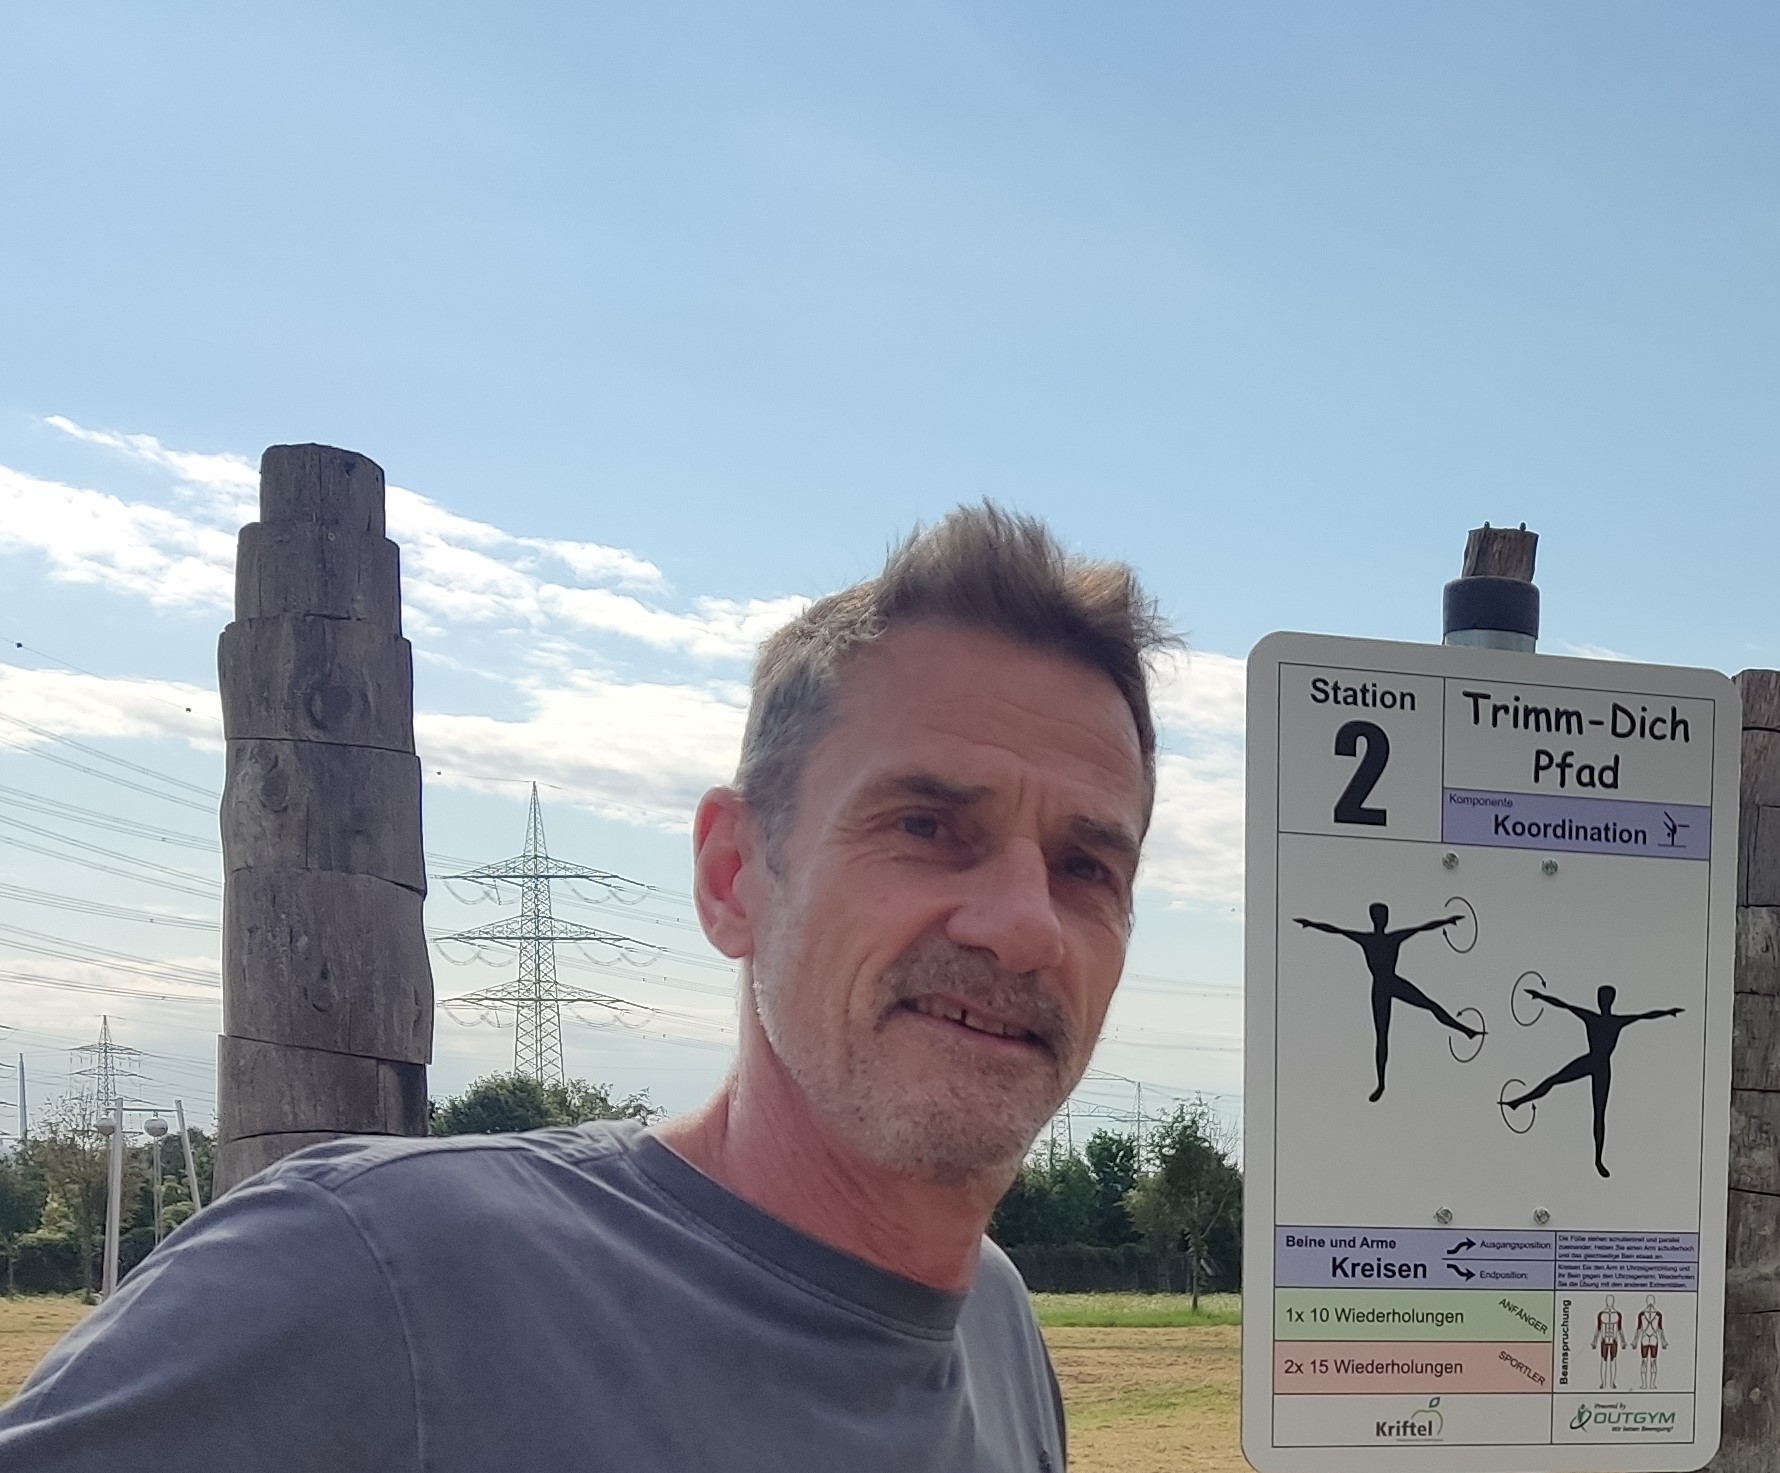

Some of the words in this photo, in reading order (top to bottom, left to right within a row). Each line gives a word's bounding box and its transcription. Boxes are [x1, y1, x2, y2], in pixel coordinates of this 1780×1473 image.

[1310, 677, 1416, 711] Station
[1462, 690, 1690, 743] Trimm-Dich
[1334, 720, 1390, 827] 2
[1534, 749, 1619, 789] Pfad
[1449, 793, 1513, 807] Komponente
[1494, 814, 1647, 845] Koordination
[1286, 1235, 1325, 1248] Beine
[1330, 1236, 1356, 1248] und
[1359, 1237, 1396, 1249] Arme
[1332, 1257, 1427, 1279] Kreisen
[1286, 1307, 1304, 1322] 1x
[1310, 1307, 1329, 1322] 10
[1335, 1308, 1463, 1327] Wiederholungen
[1498, 1299, 1548, 1335] ANFÄNGER
[1559, 1300, 1572, 1384] Beanspruchung
[1284, 1359, 1304, 1374] 2x
[1310, 1359, 1329, 1374] 15
[1334, 1359, 1463, 1377] Wiederholungen
[1498, 1351, 1545, 1386] SPORTLER
[1376, 1420, 1432, 1436] Kriftel
[1594, 1412, 1676, 1424] OUTGYM
